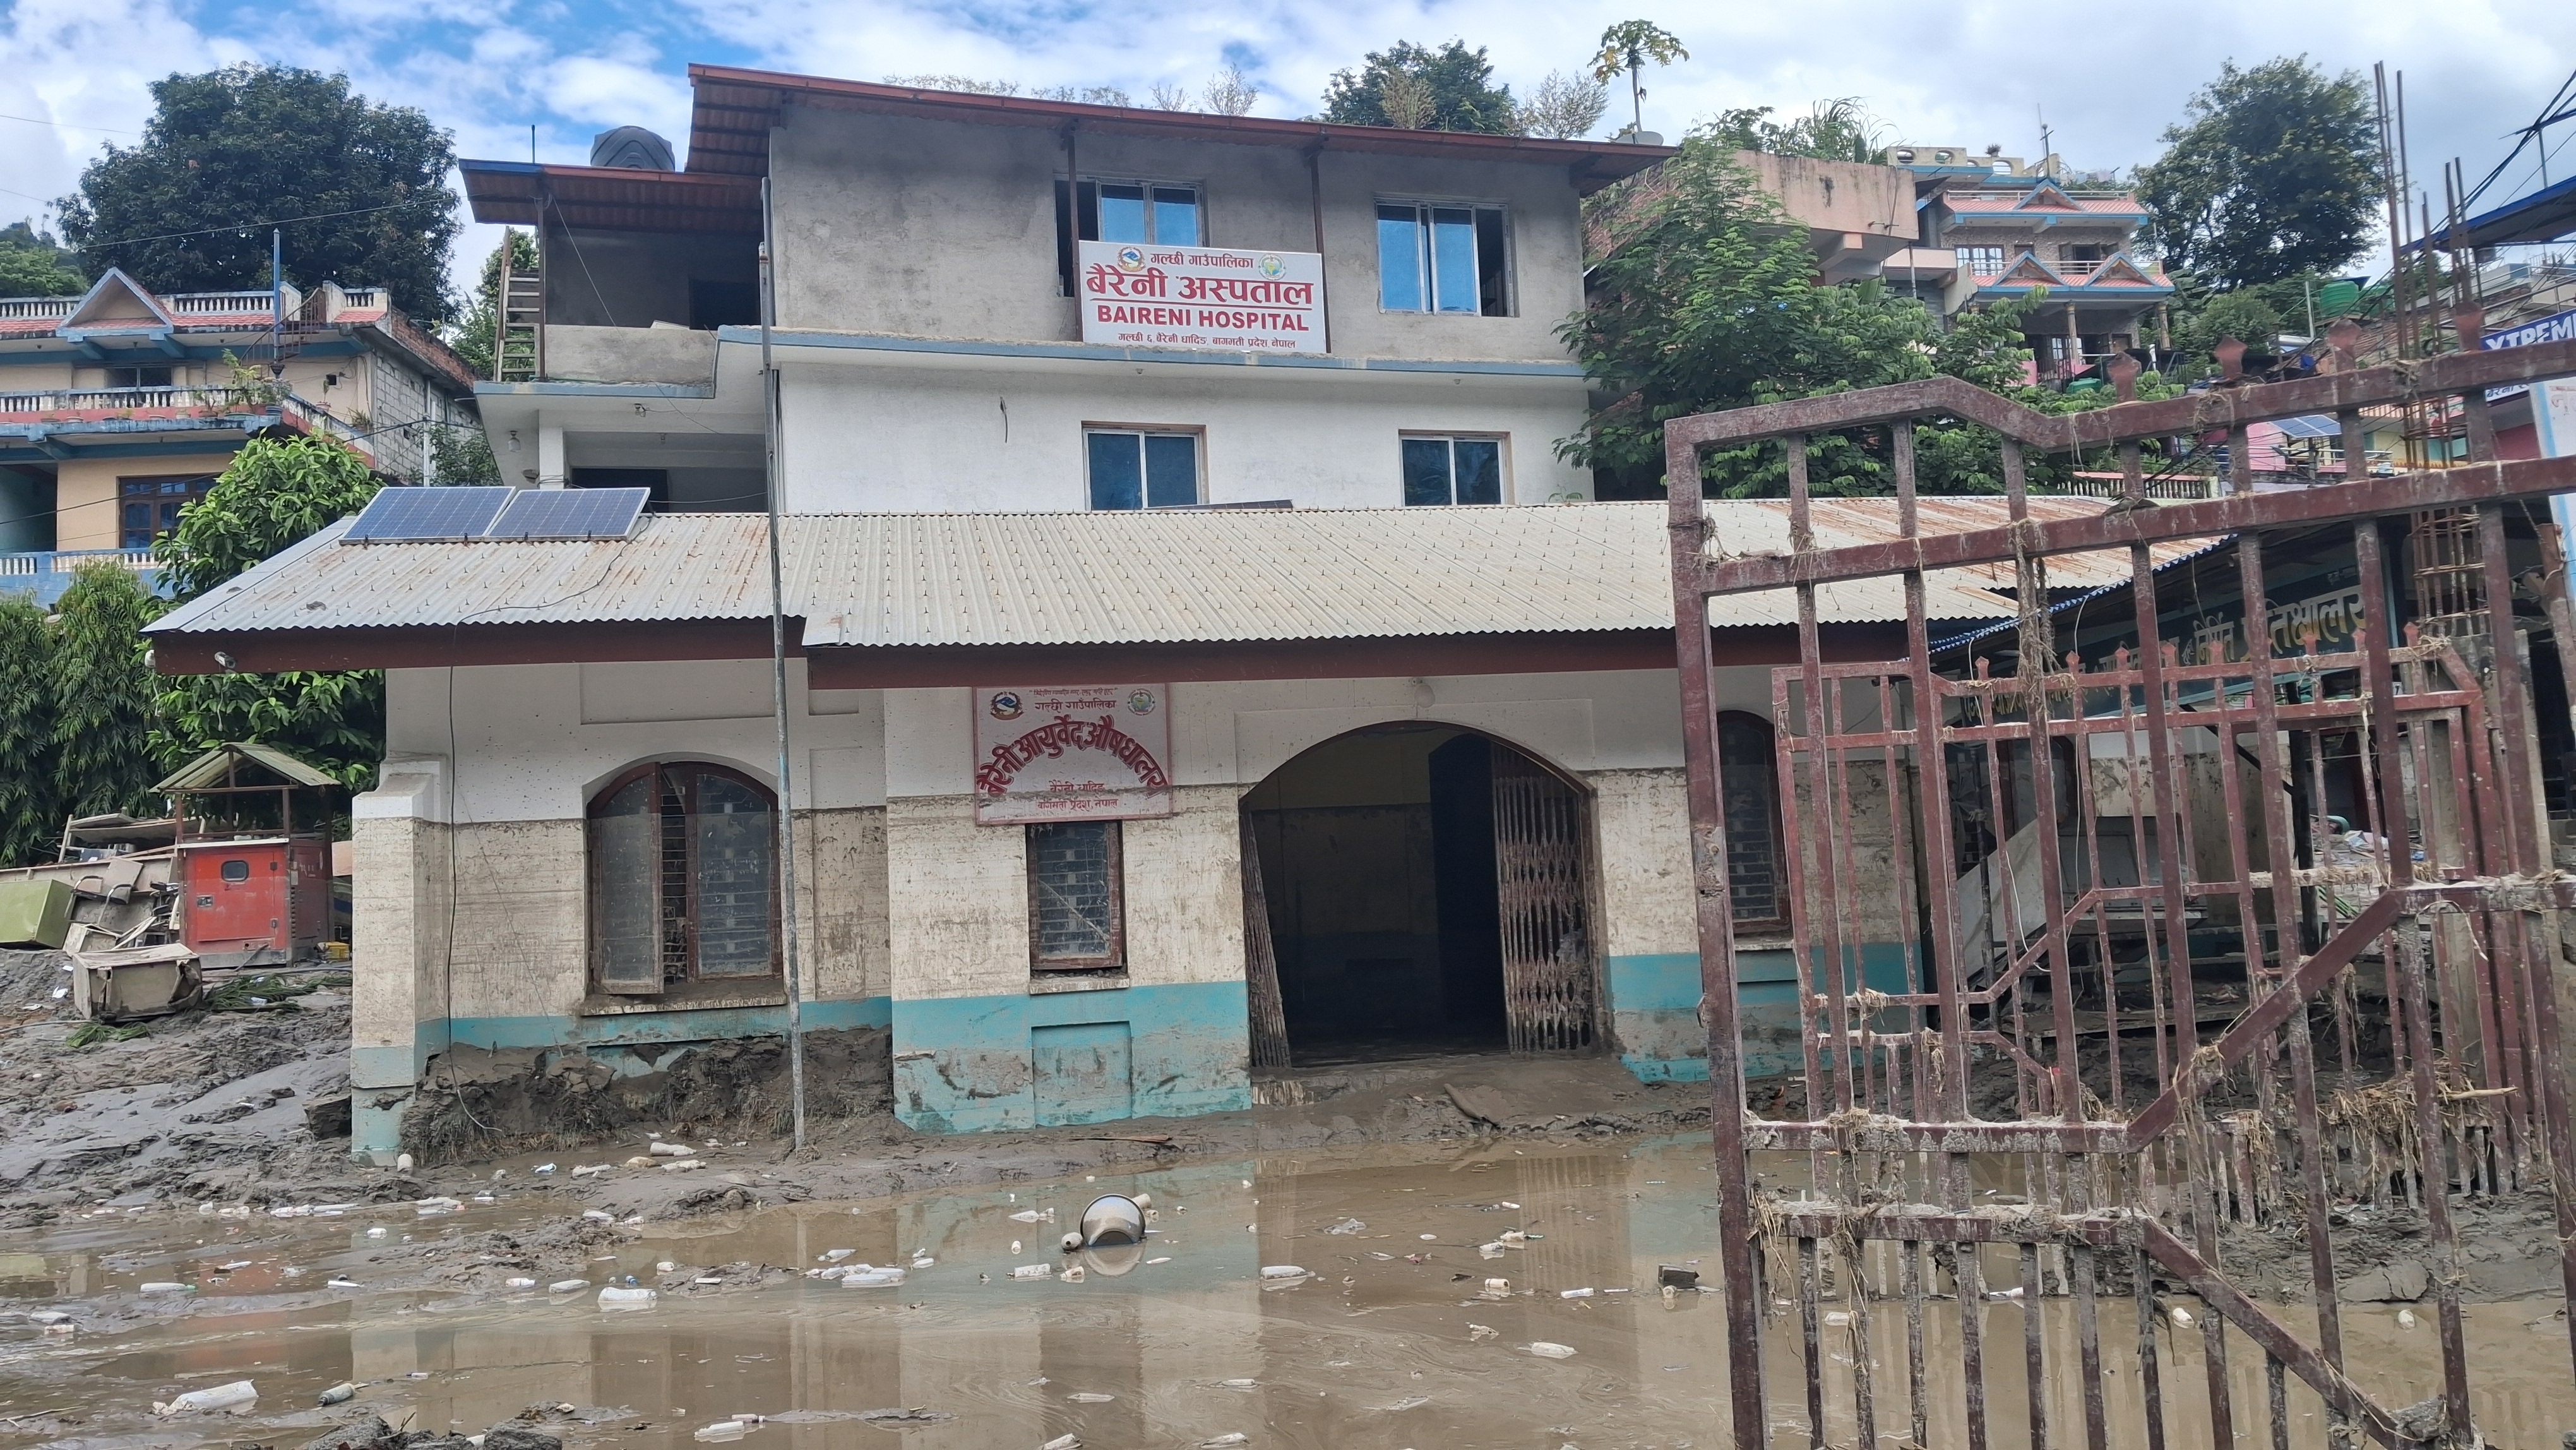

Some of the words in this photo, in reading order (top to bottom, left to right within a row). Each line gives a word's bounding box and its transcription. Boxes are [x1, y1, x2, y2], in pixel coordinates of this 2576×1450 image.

[1188, 253, 1254, 268] गाउँपालिका
[1086, 263, 1168, 297] बैरेनी
[1176, 275, 1314, 304] अस्पताल
[1097, 305, 1191, 327] BAIRENI
[1200, 310, 1309, 331] HOSPITAL
[1272, 337, 1296, 348] नेपाल
[2485, 313, 2576, 350] XTREM
[1065, 698, 1117, 710] गाउँपालिका
[1083, 714, 1169, 799] औषधालय
